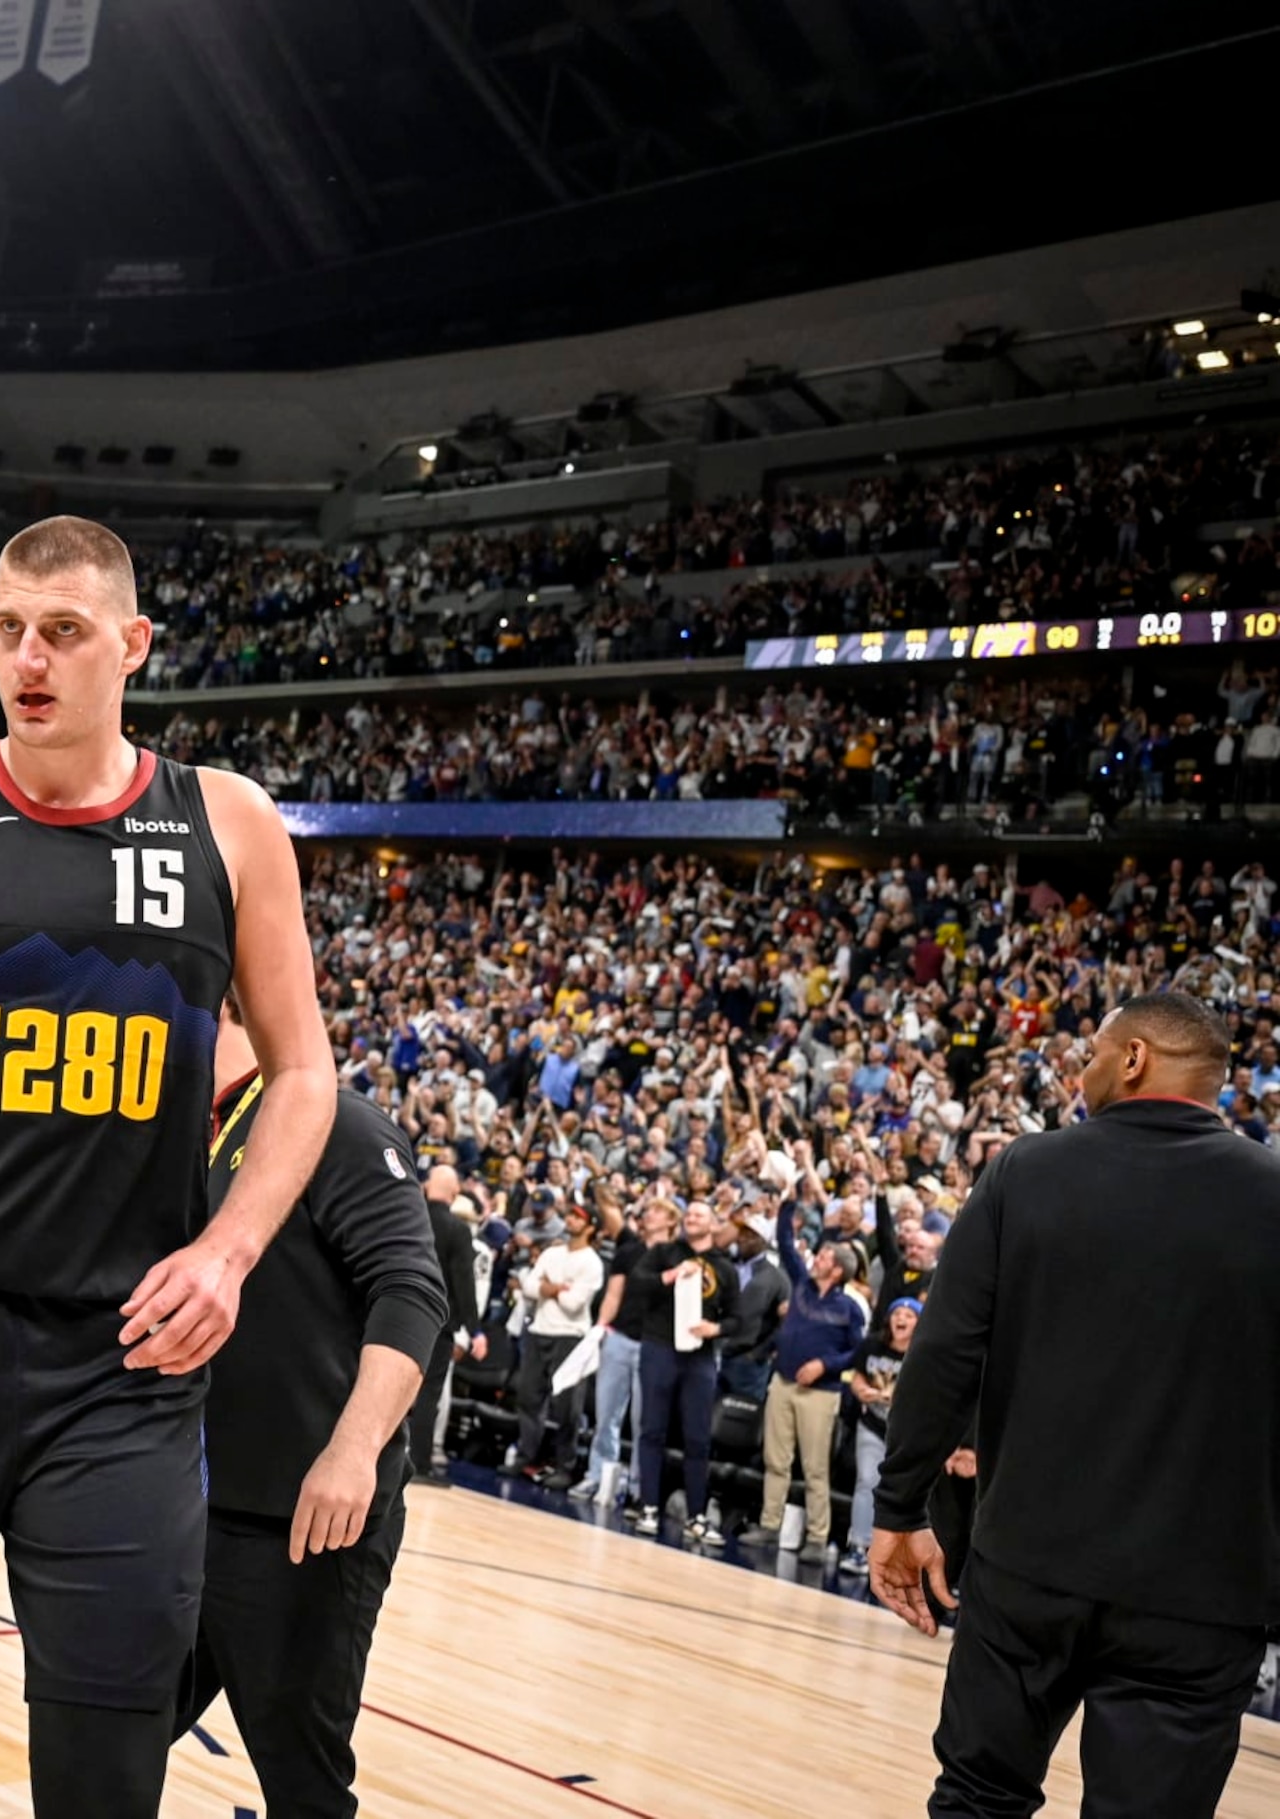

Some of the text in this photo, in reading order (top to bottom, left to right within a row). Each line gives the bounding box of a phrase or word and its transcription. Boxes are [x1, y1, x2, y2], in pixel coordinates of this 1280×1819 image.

[1046, 625, 1079, 649] 99
[1139, 611, 1182, 637] 0.0
[1243, 612, 1280, 638] 10
[124, 817, 190, 835] ibotta
[111, 847, 185, 928] 15
